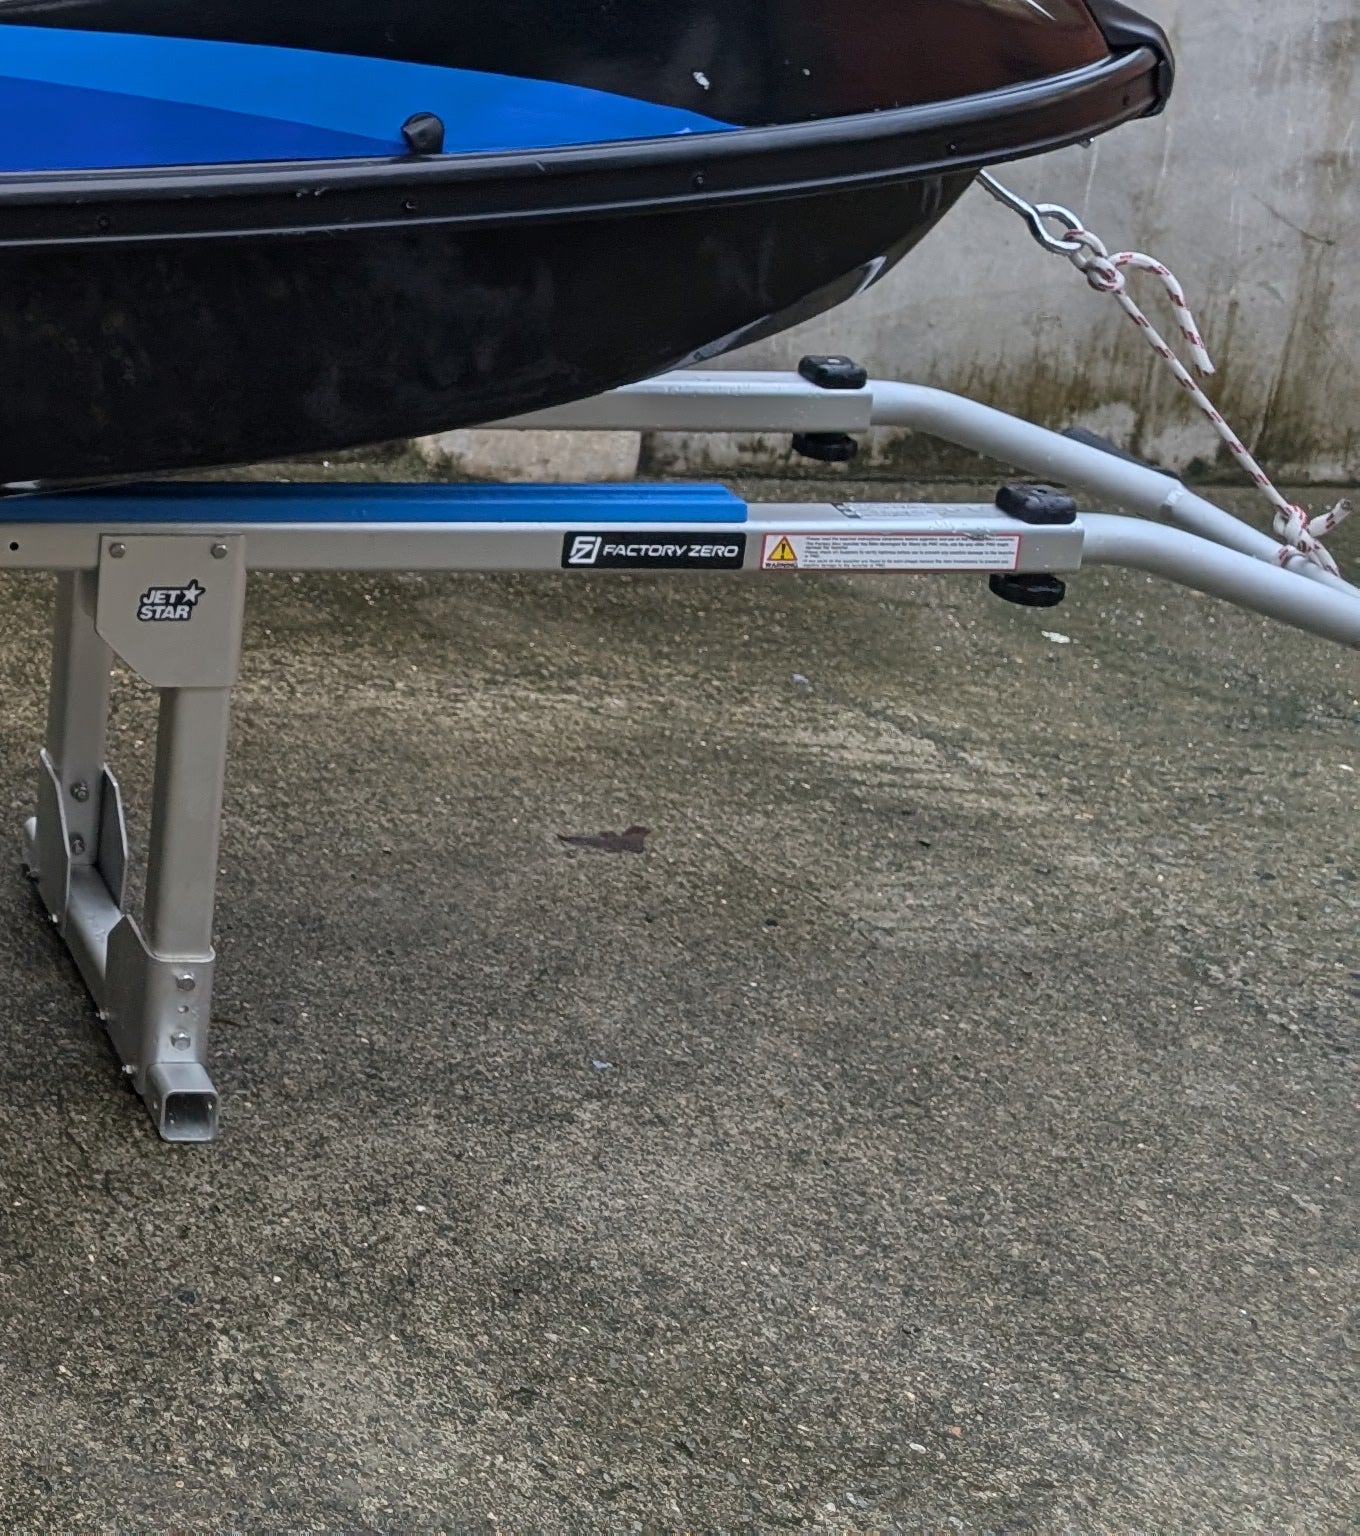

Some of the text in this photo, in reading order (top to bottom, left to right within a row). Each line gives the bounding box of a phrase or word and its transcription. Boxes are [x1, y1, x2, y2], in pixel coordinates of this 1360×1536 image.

[602, 544, 739, 558] FACTORY ZERO
[143, 590, 181, 604] JET
[140, 605, 189, 619] STAR
